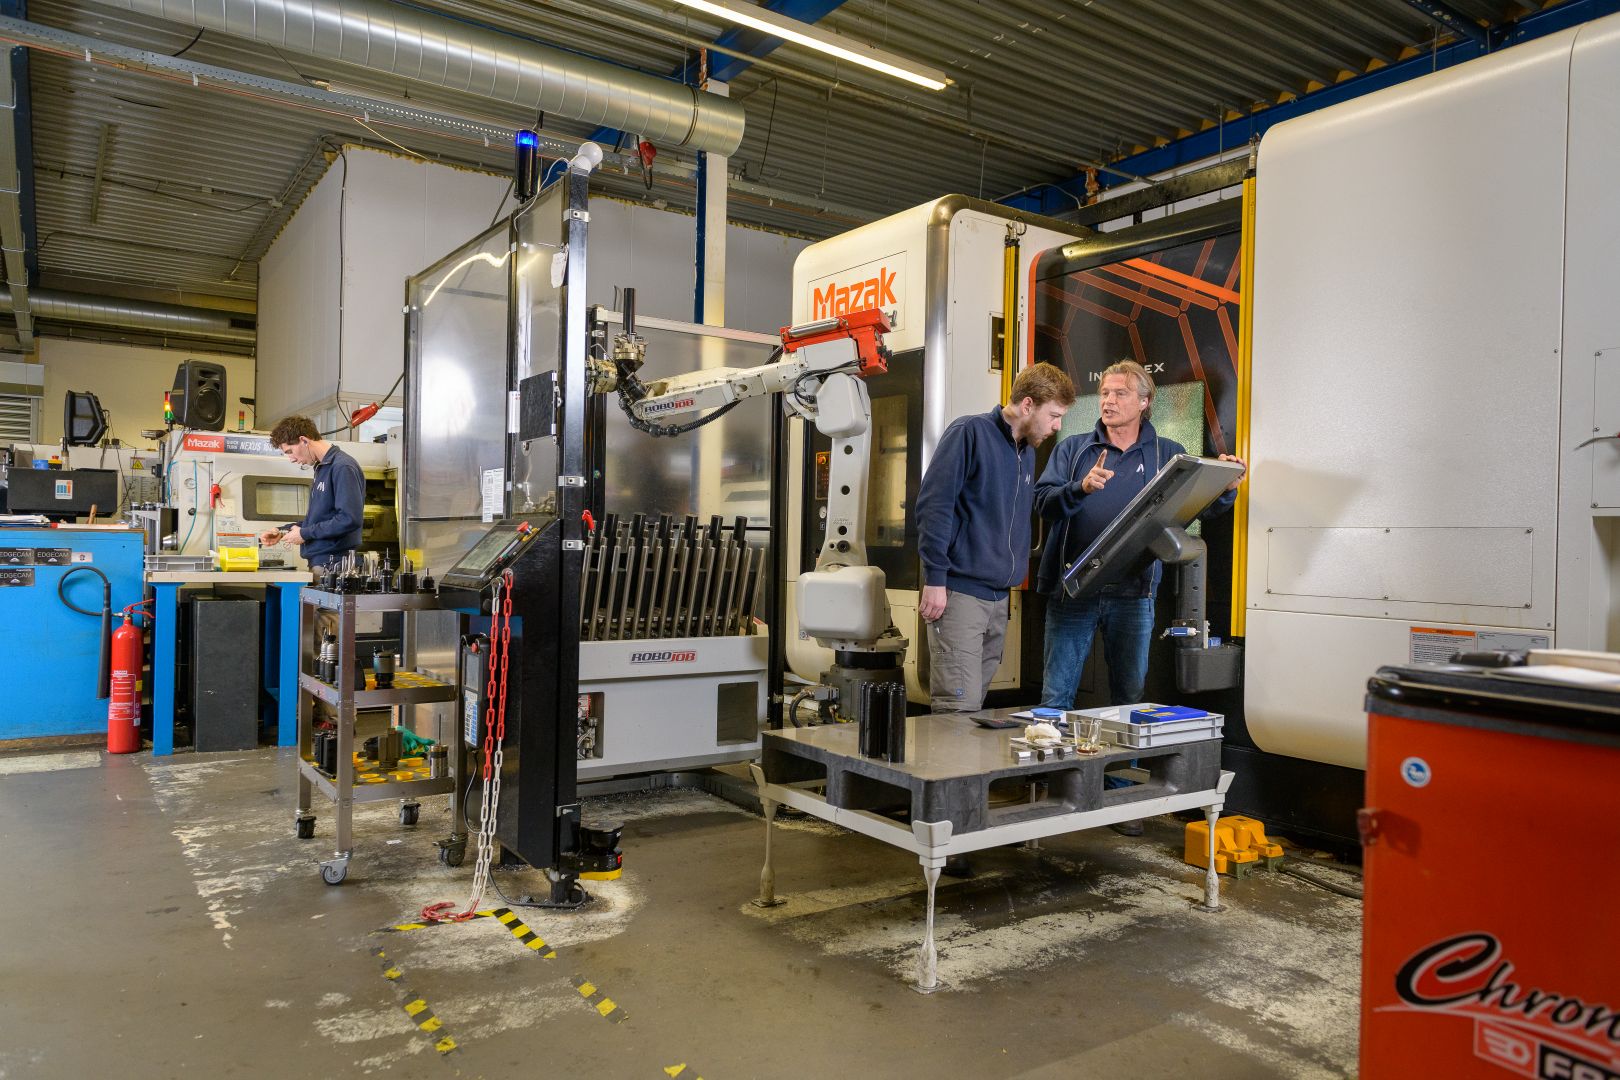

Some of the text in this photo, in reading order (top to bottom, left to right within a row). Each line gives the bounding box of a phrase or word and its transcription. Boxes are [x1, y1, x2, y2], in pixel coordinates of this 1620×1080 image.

[813, 267, 897, 321] Mazak
[187, 438, 220, 449] Mazak
[240, 441, 261, 451] NEXUS
